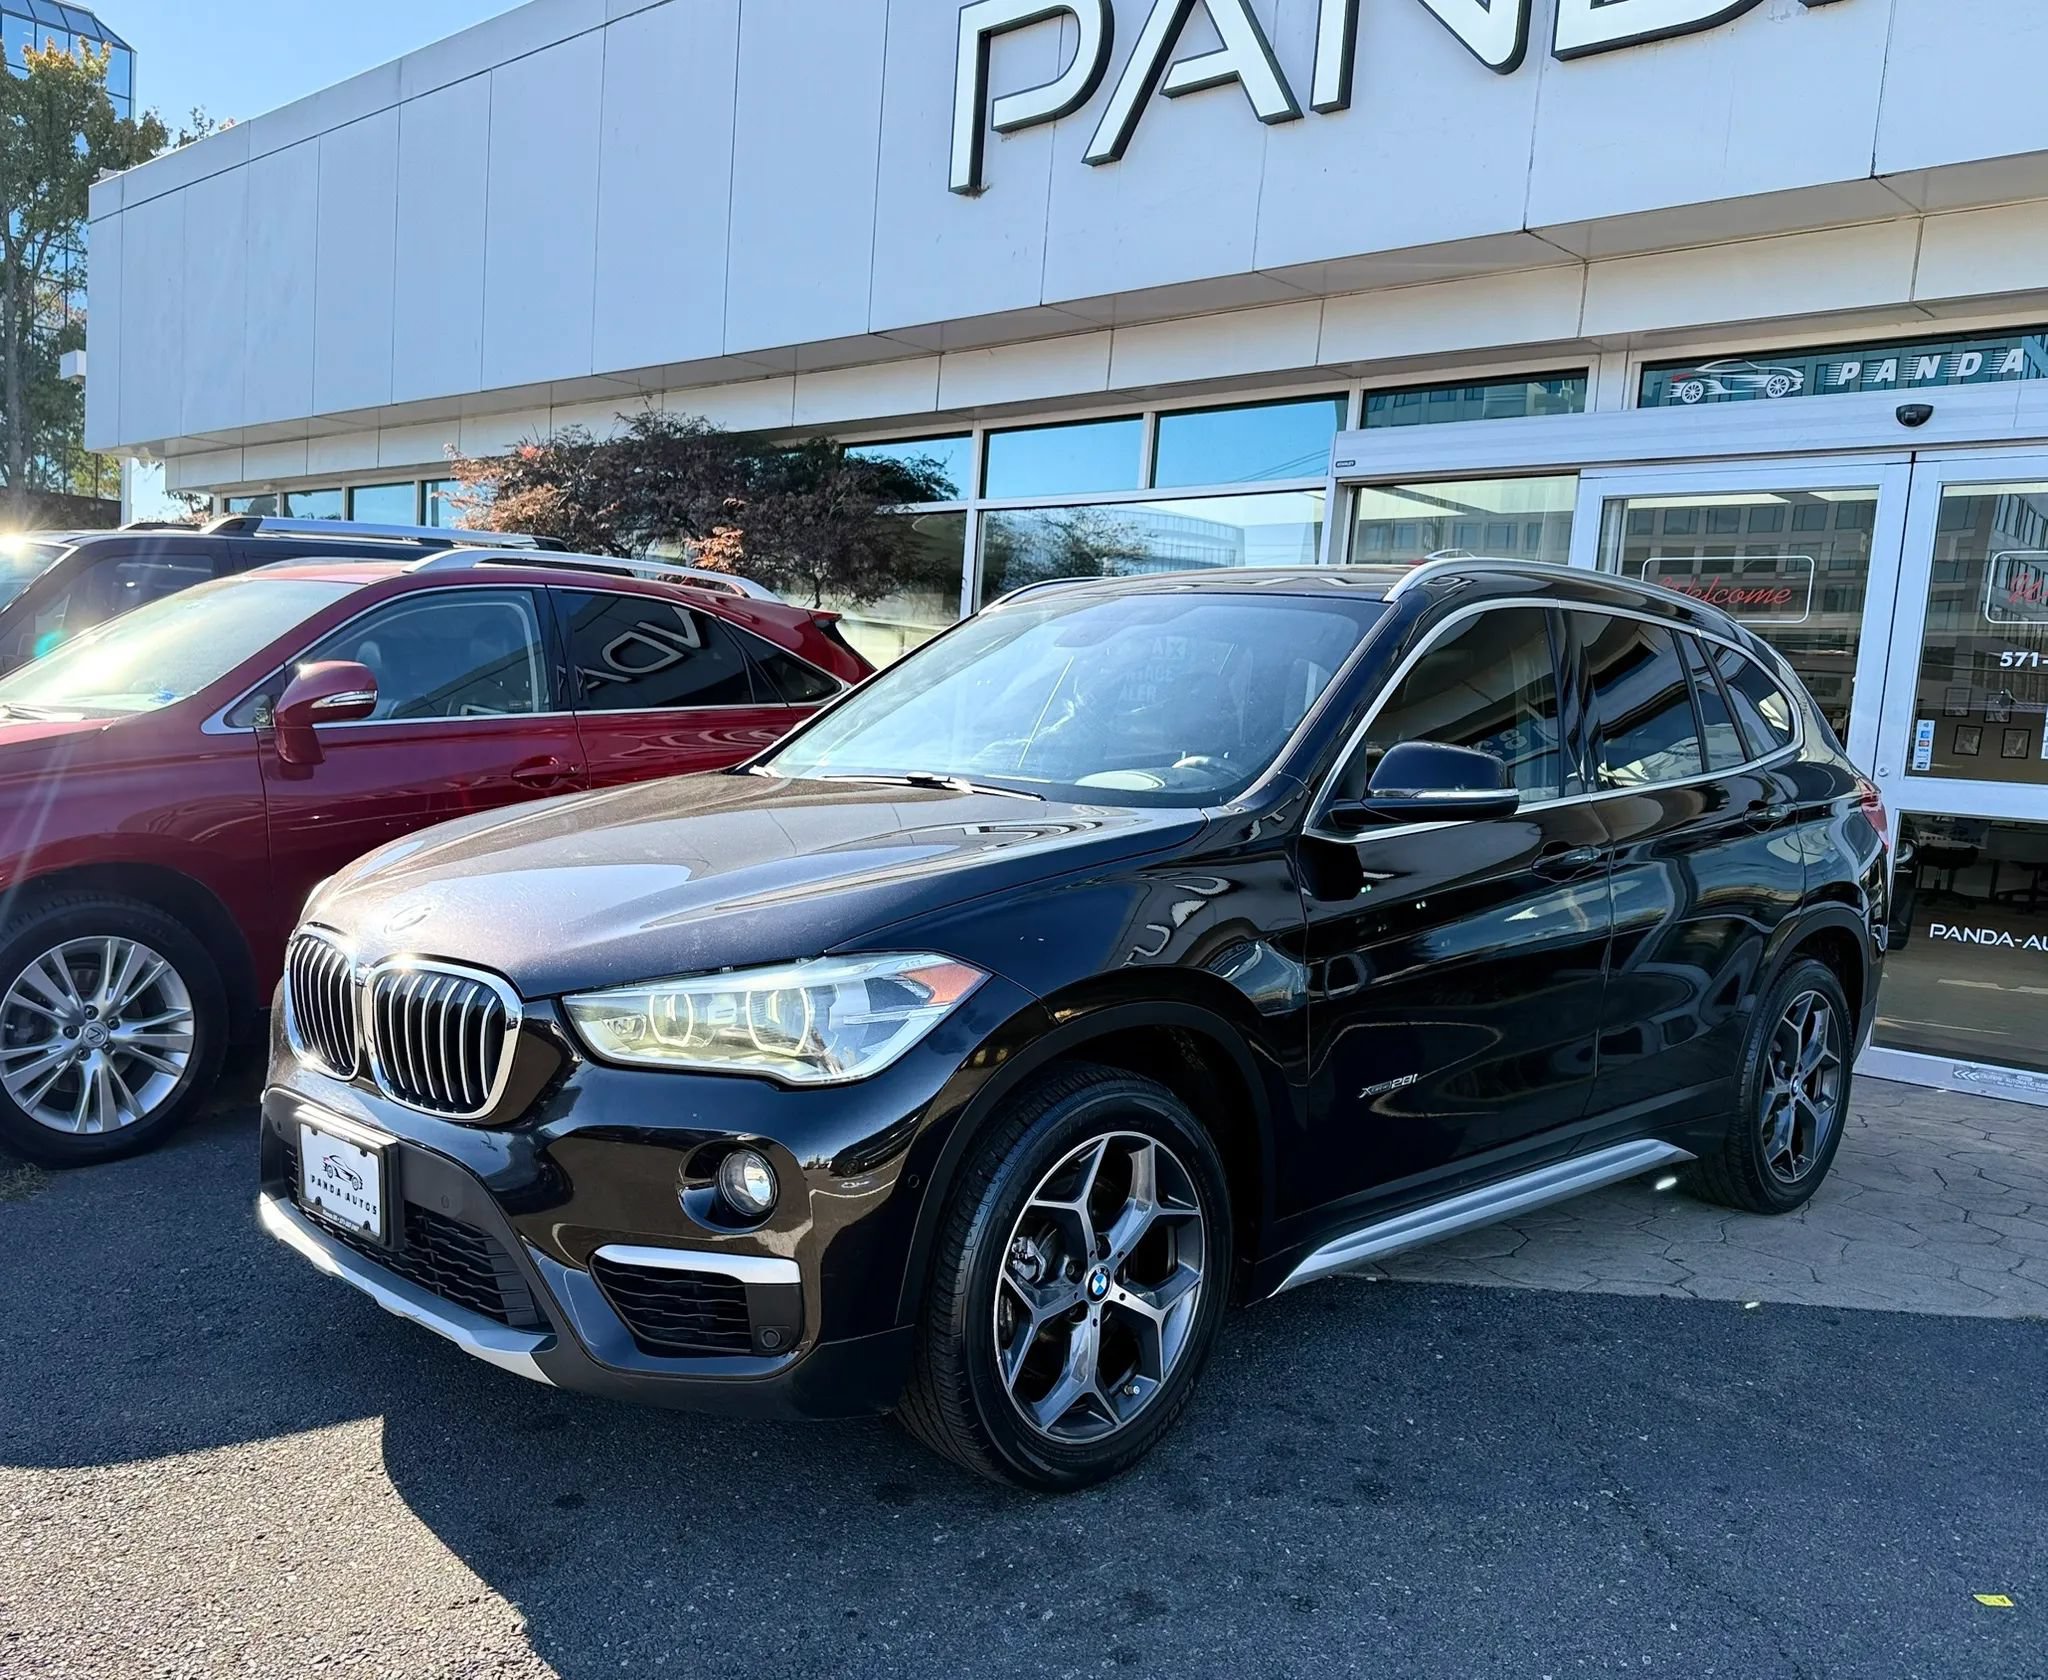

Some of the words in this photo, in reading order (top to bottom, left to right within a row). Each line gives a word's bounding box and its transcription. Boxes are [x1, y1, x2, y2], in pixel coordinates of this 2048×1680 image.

[948, 0, 1845, 196] PAN
[1824, 348, 2025, 386] PANDA
[2000, 652, 2048, 667] 571-
[310, 1174, 342, 1197] PANDA
[345, 1192, 377, 1215] AUTOS
